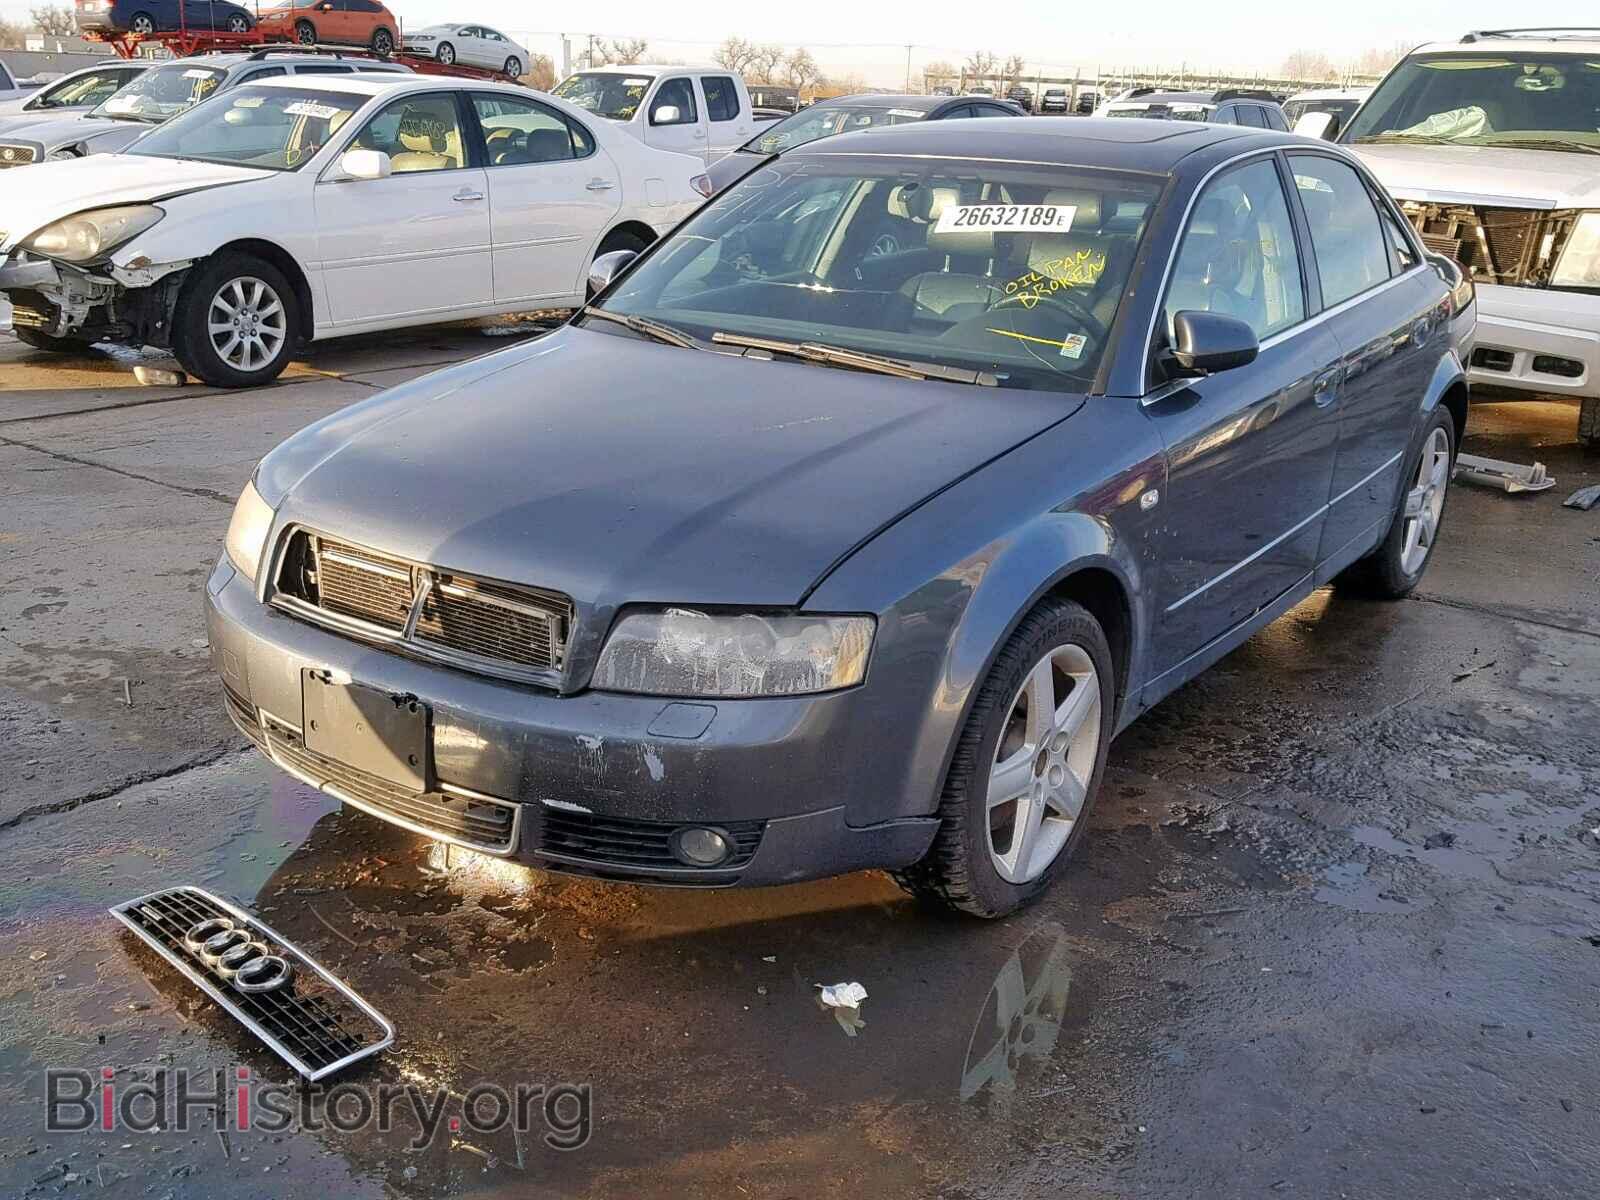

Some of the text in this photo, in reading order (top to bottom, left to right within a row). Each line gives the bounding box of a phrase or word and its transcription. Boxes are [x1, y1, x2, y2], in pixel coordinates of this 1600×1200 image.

[953, 207, 1067, 226] 26632189 E
[1006, 248, 1092, 295] OIL PAN
[1017, 256, 1106, 309] BROKEN
